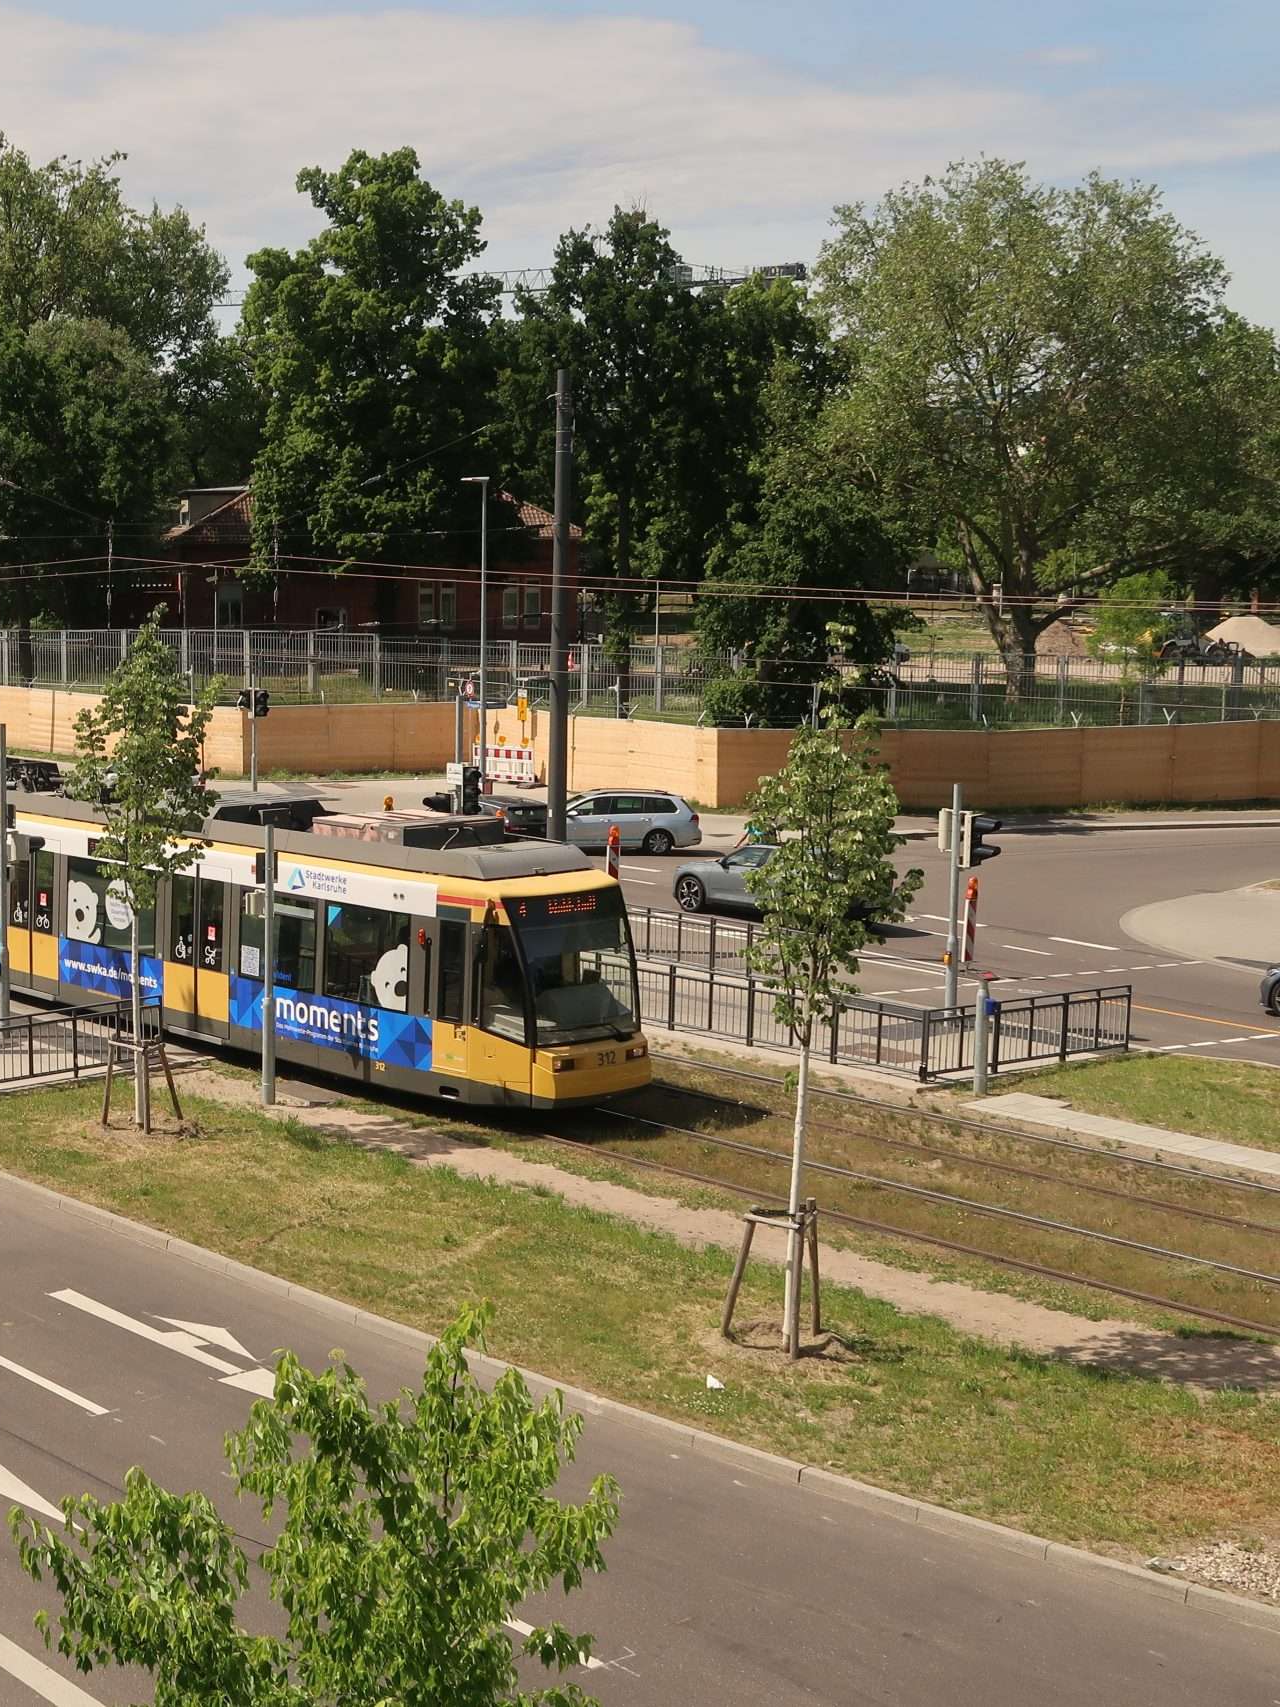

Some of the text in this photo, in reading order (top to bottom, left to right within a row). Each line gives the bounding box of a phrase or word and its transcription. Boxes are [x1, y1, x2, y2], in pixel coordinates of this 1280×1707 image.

[305, 870, 347, 885] Stadtwerke
[312, 880, 347, 895] Karlsruhe
[64, 958, 158, 989] www.swka.de/moents
[597, 1050, 617, 1066] 312
[375, 1060, 386, 1072] 312
